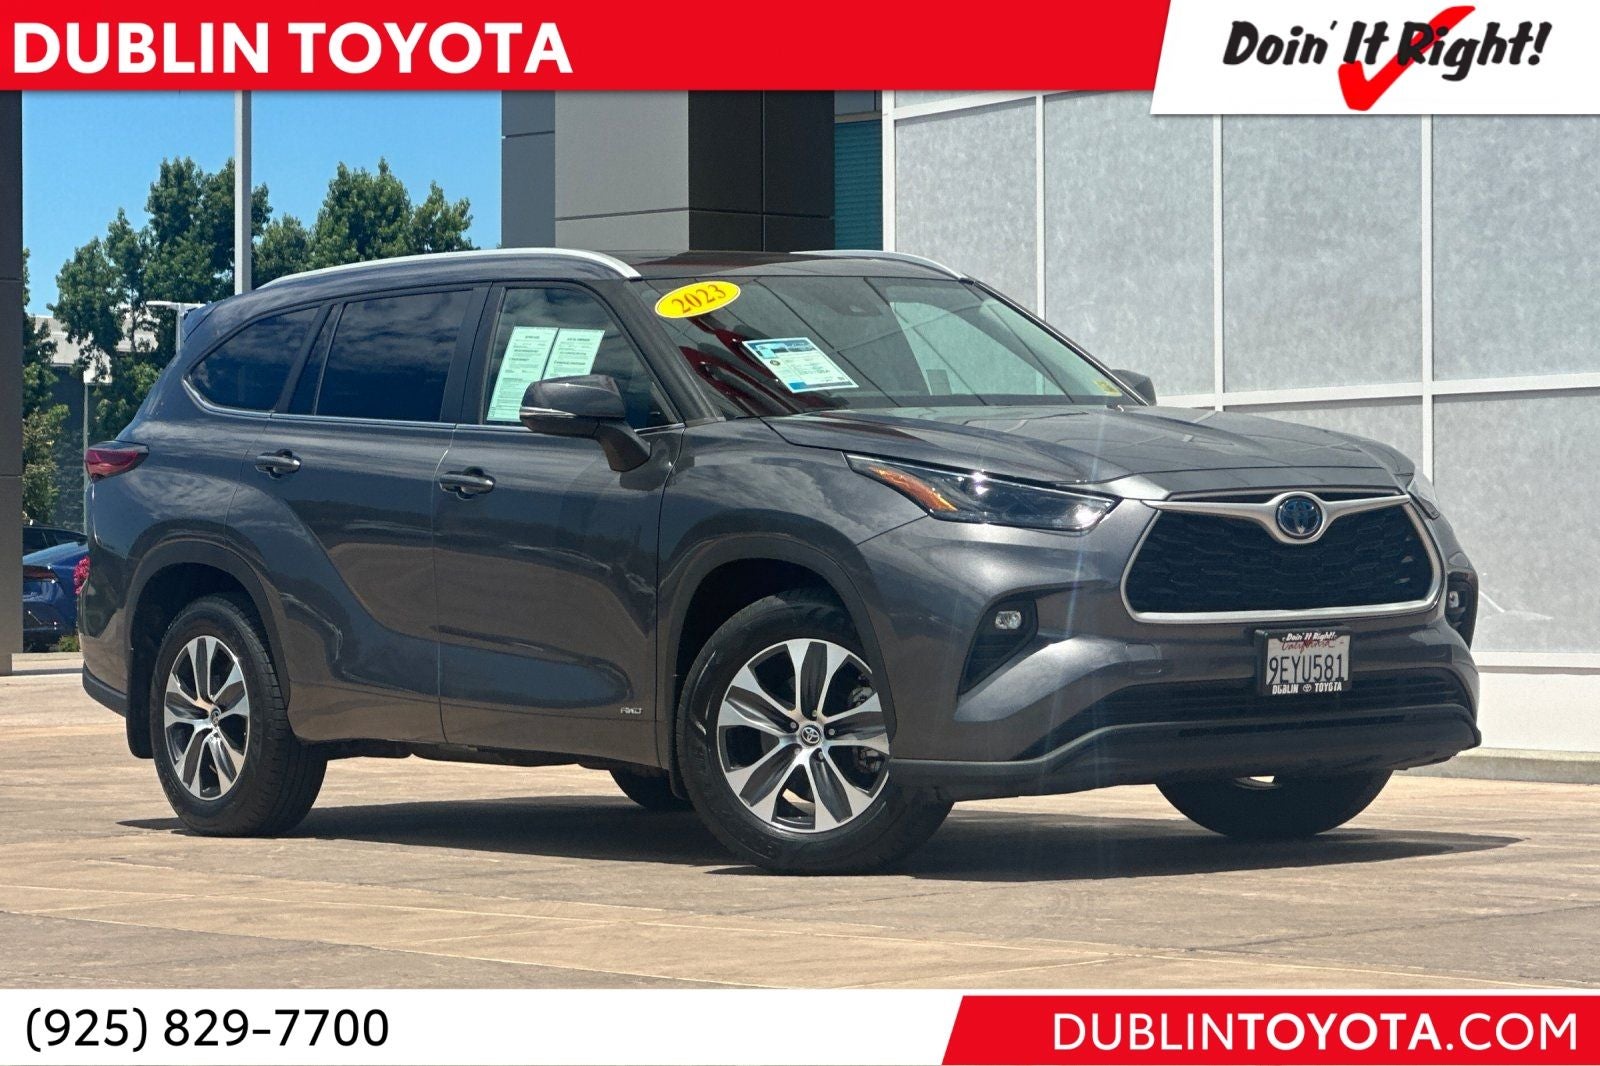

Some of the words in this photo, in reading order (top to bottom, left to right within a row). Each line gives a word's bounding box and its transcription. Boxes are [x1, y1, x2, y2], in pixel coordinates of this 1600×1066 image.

[671, 284, 727, 314] 2023
[1268, 654, 1344, 684] 9EYU581
[1272, 683, 1300, 695] DUBLIN
[1314, 681, 1342, 693] TOYOTA
